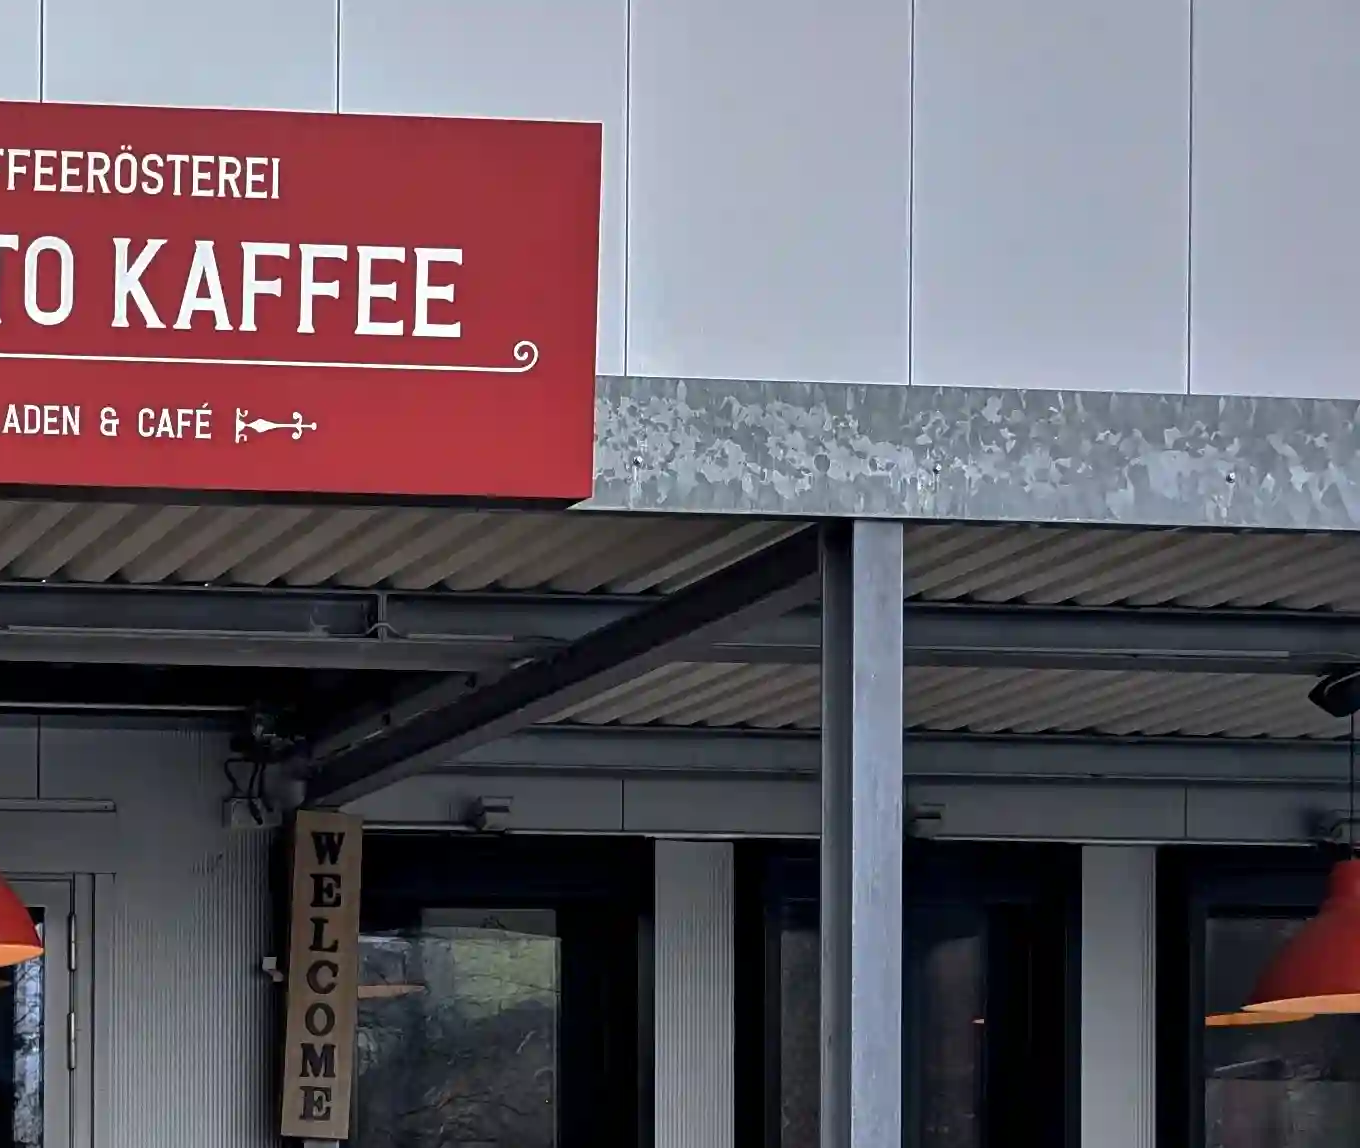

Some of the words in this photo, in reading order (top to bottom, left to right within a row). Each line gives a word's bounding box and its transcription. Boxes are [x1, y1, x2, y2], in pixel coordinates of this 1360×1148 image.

[111, 237, 463, 338] KAFFEE
[99, 406, 120, 437] &
[138, 402, 213, 440] CAFÉ
[298, 831, 346, 1122] WELCOME
